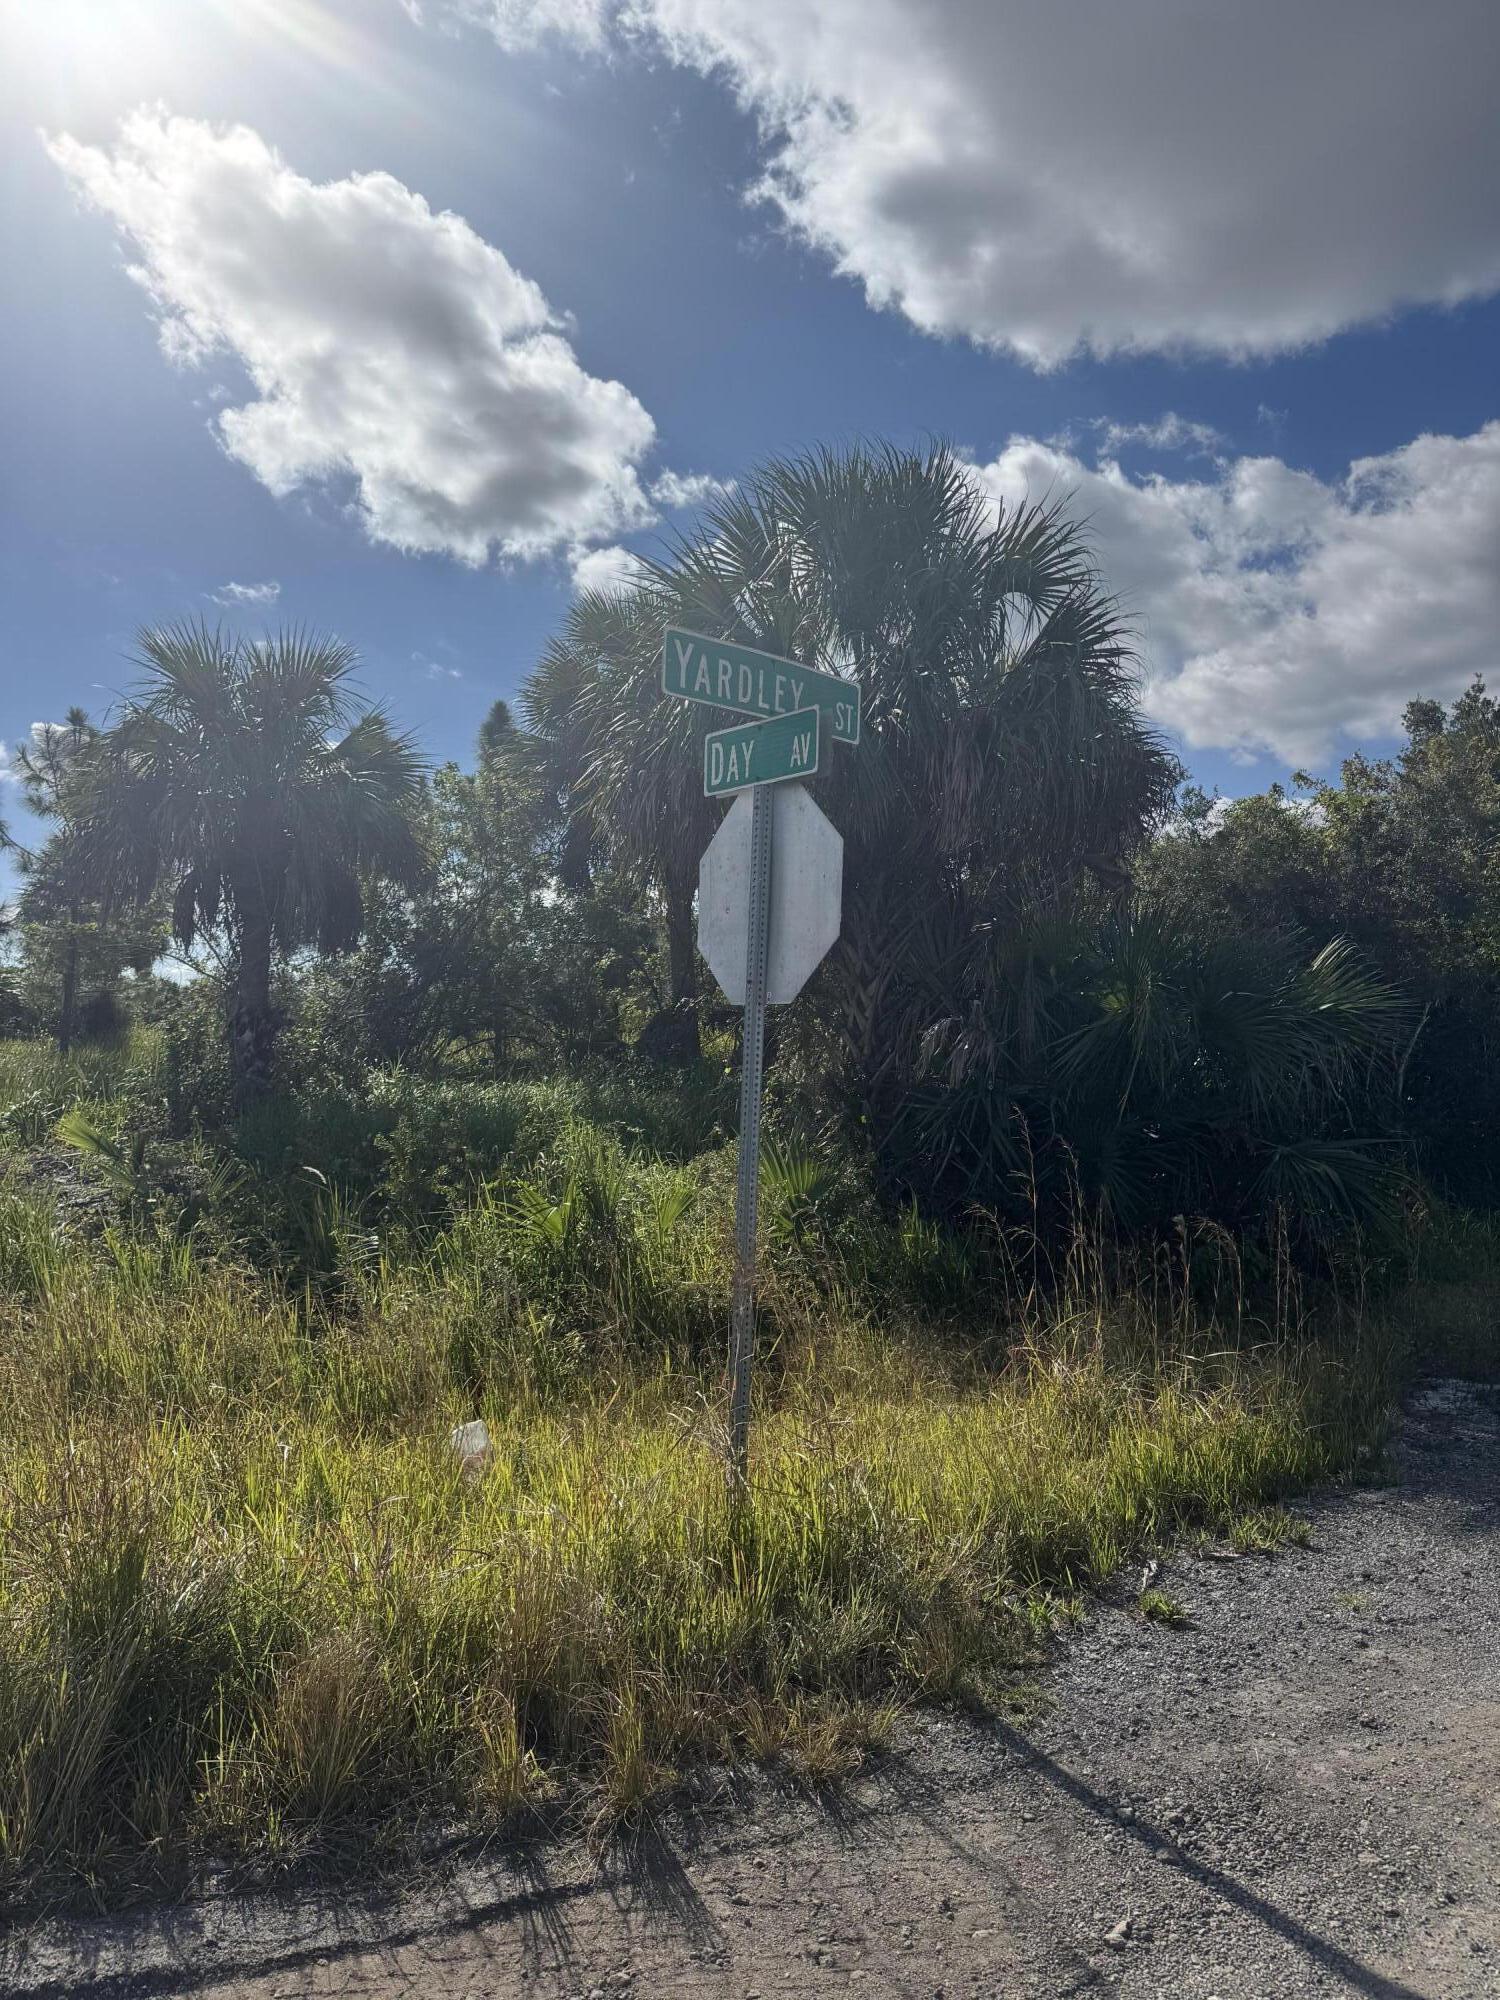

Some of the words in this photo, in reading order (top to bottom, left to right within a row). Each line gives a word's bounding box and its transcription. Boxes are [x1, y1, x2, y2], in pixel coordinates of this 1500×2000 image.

[674, 639, 804, 713] YARDLEY
[835, 702, 854, 734] ST
[711, 740, 755, 786] DAY
[790, 731, 811, 768] AV
